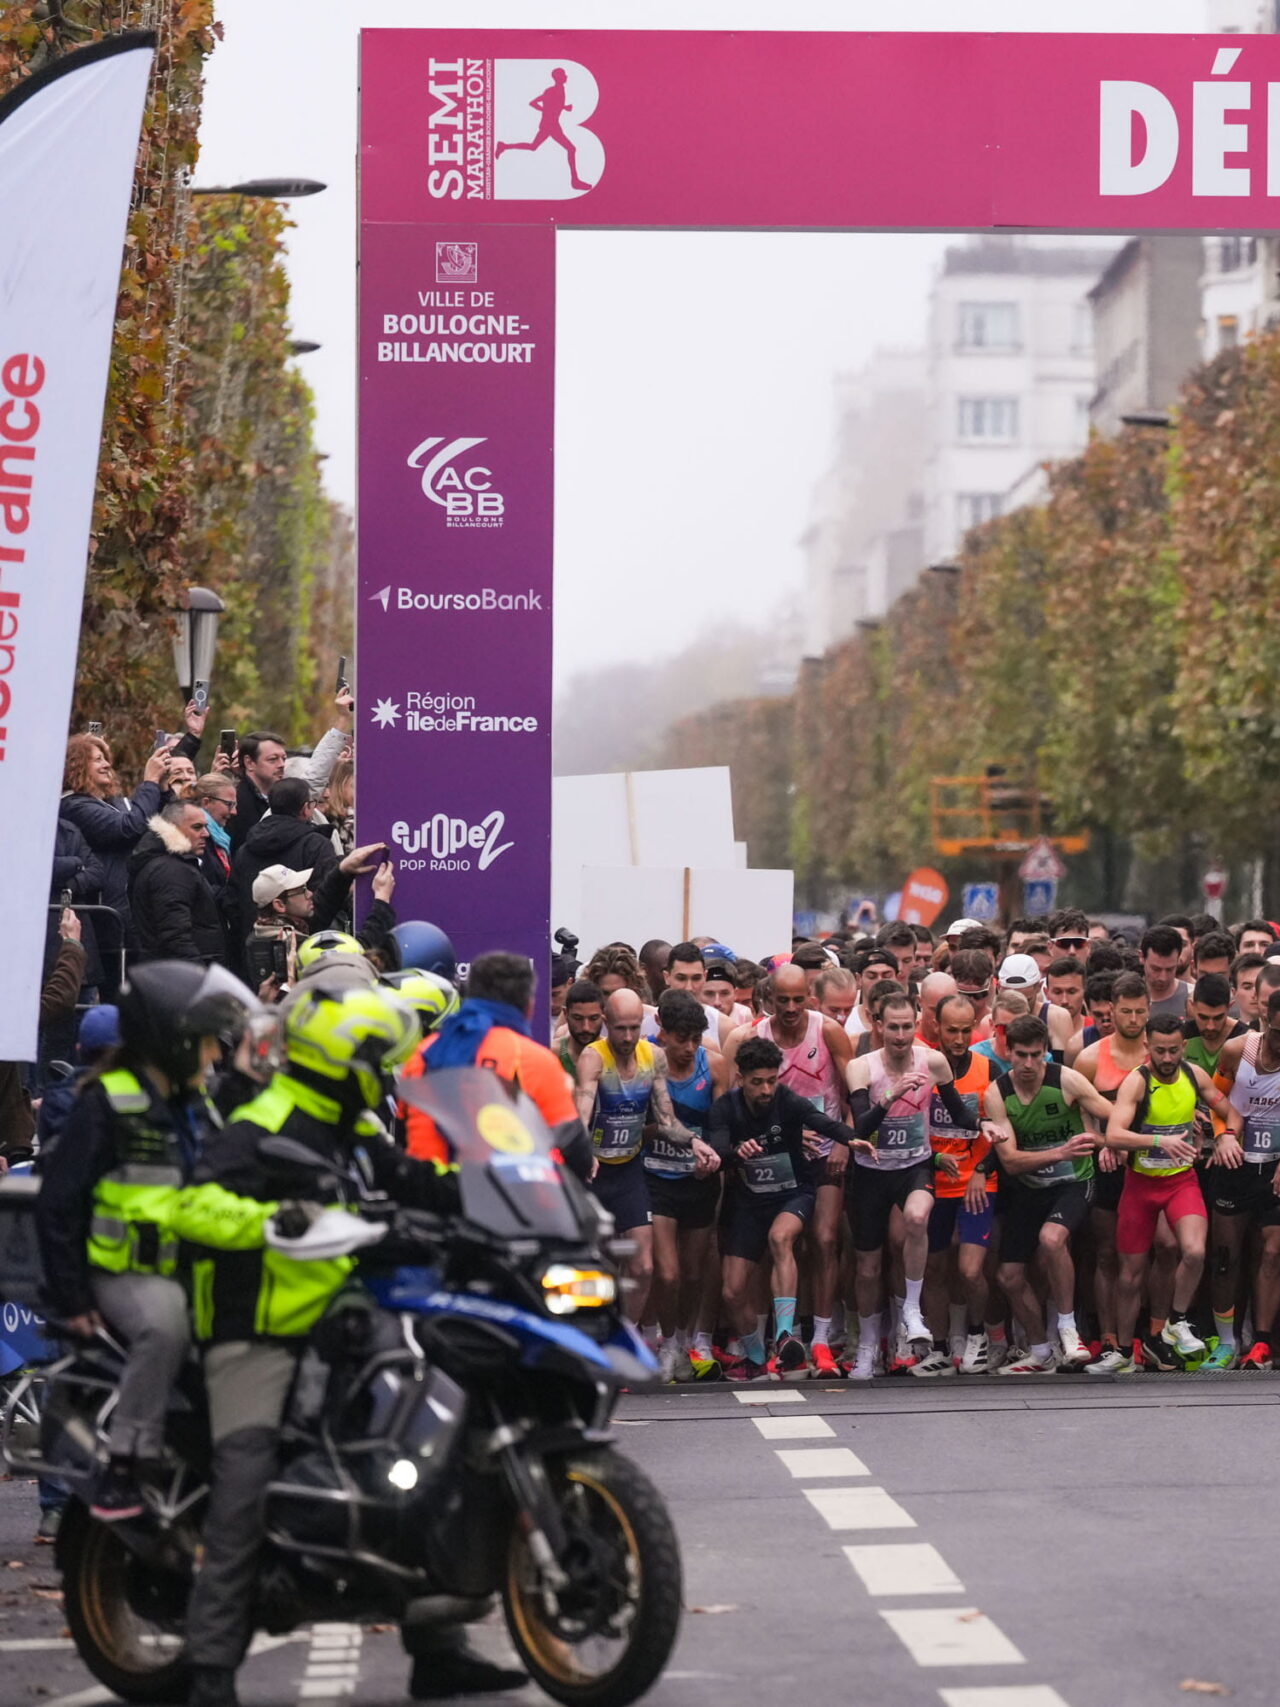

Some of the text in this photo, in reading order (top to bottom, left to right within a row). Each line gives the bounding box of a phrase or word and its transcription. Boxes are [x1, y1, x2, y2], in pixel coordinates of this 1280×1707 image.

[427, 58, 464, 200] SEMI
[466, 58, 484, 200] MARATHON
[418, 291, 495, 307] VILLE DE
[383, 314, 529, 335] BOULOGNE-
[377, 342, 535, 363] BILLANCOURT
[397, 587, 543, 611] BoursoBank
[406, 691, 476, 714] Région
[400, 859, 471, 871] POP RADIO
[611, 1129, 630, 1145] 10
[887, 1129, 907, 1145] 20
[1253, 1131, 1271, 1148] 16
[754, 1168, 775, 1182] 22
